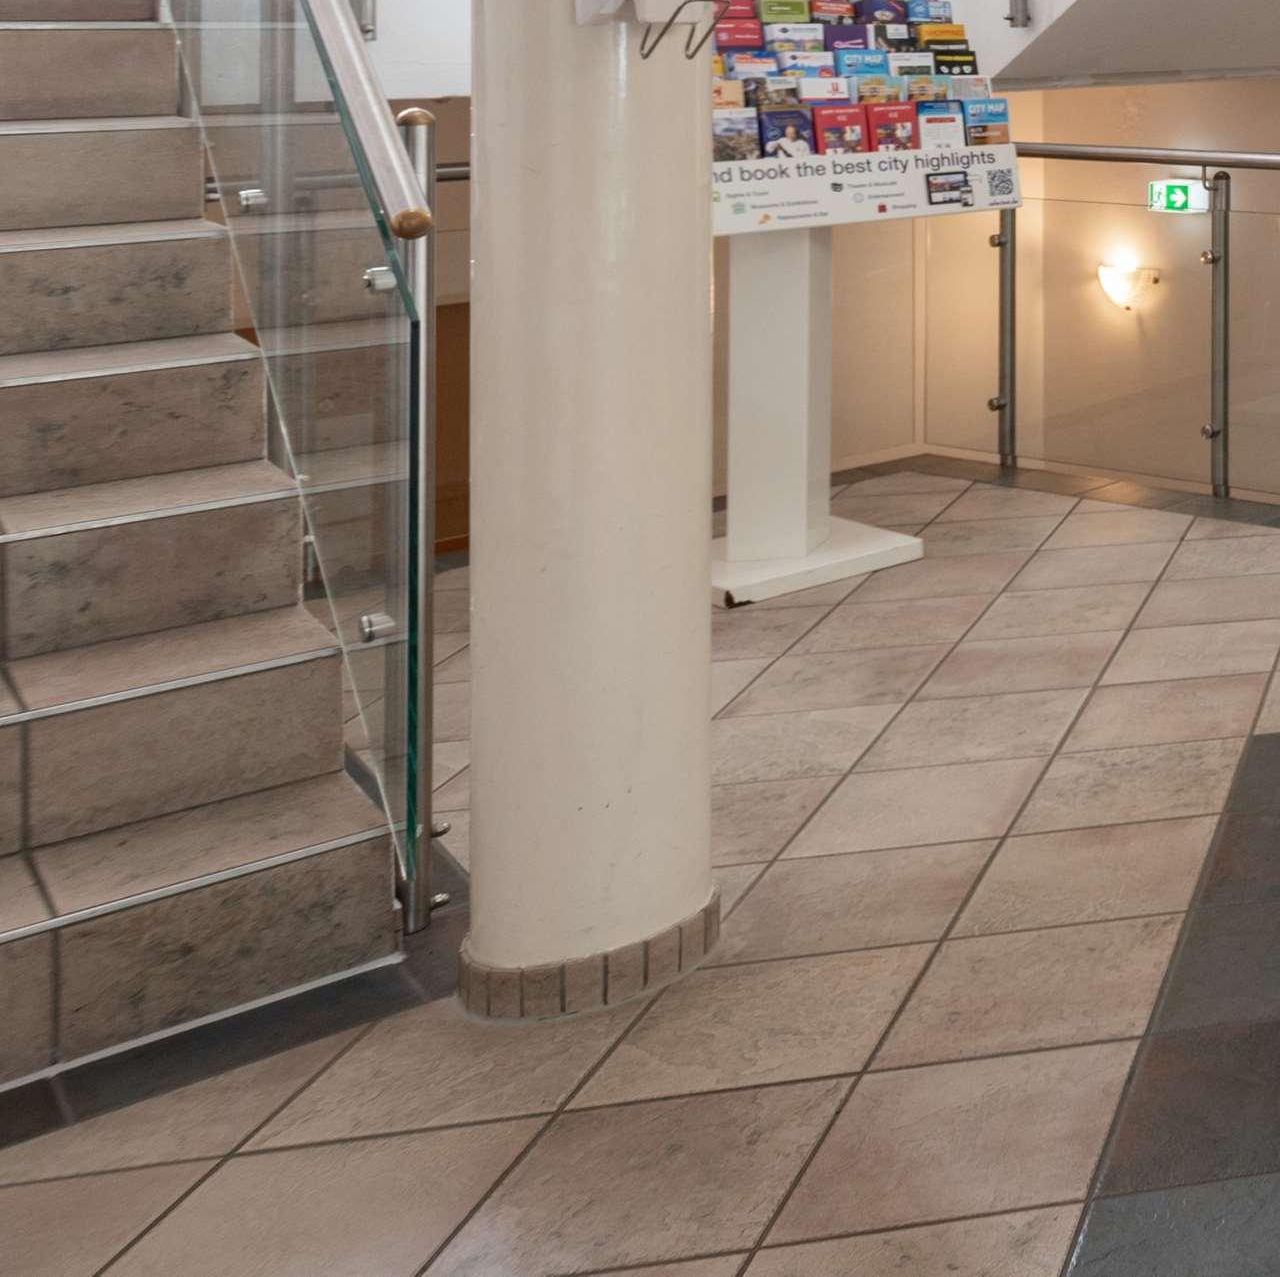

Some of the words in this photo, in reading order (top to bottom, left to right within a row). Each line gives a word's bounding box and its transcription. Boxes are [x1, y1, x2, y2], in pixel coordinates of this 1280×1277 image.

[968, 104, 986, 114] CITY
[987, 103, 1006, 113] MAP
[712, 166, 733, 184] nd
[739, 163, 790, 182] book
[796, 162, 826, 178] the
[832, 159, 873, 176] best
[878, 156, 909, 173] city
[915, 151, 996, 171] highlights
